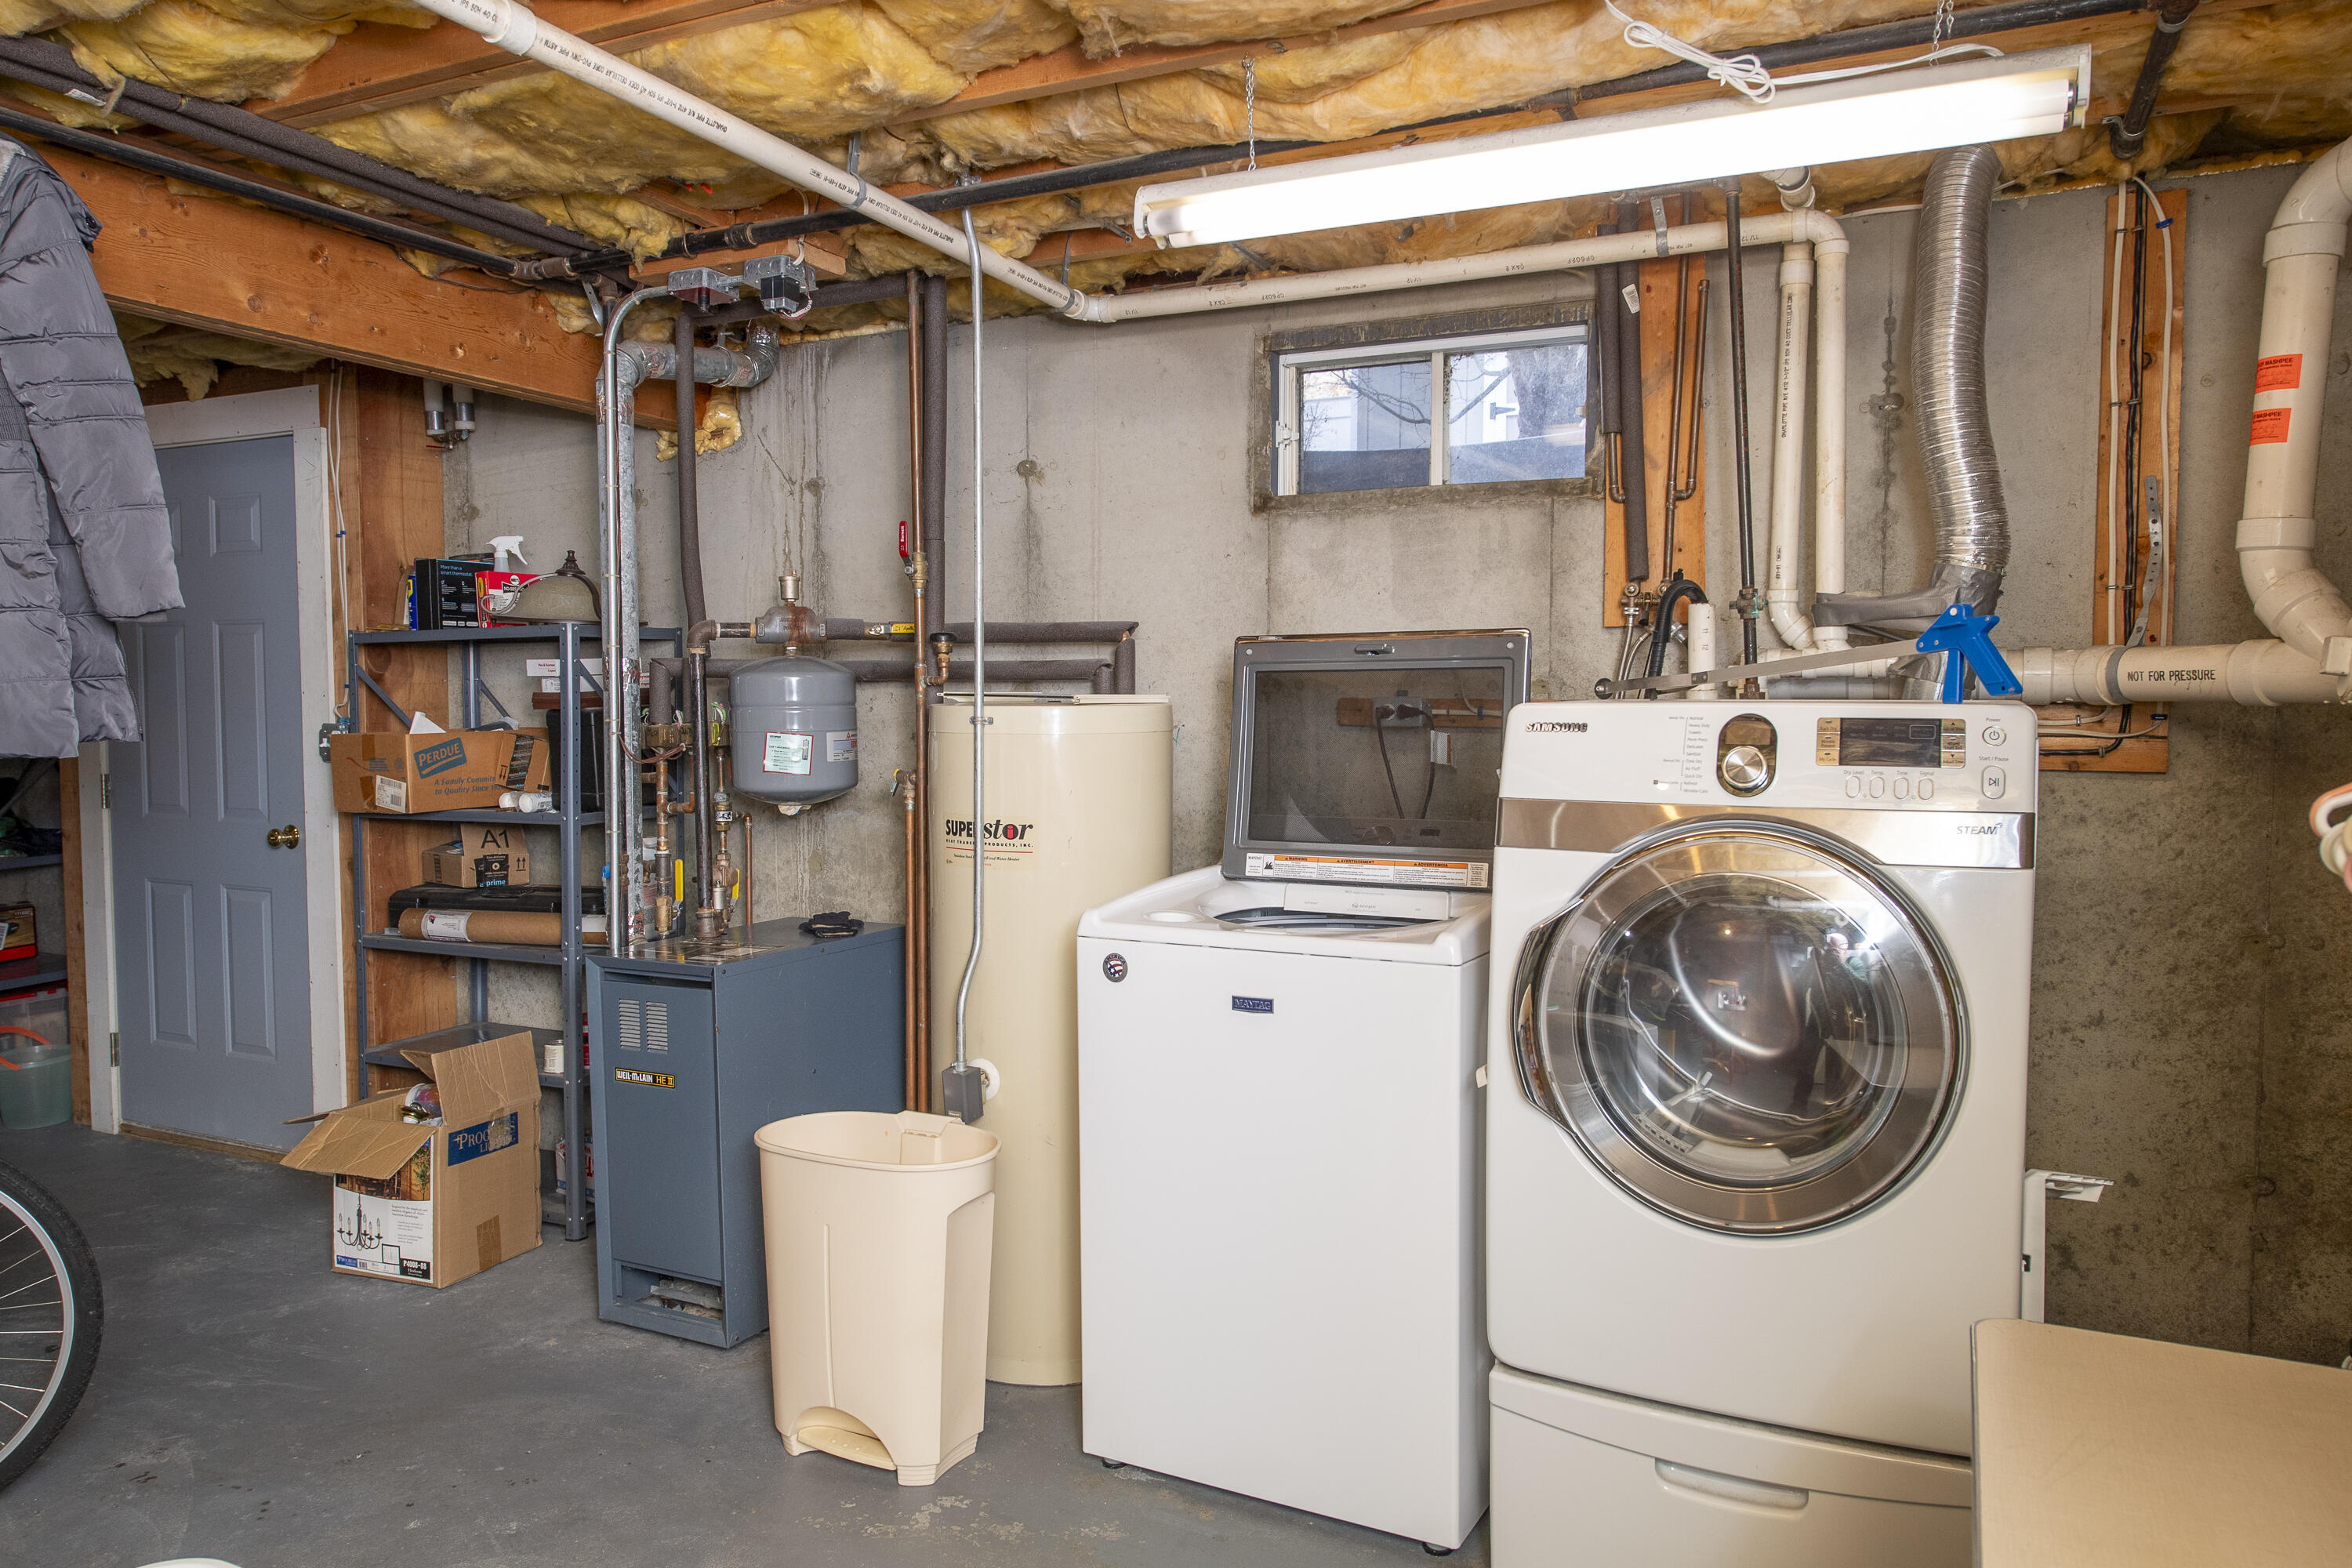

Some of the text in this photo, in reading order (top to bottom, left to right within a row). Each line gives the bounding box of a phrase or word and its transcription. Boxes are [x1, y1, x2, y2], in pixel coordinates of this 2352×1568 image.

[483, 9, 491, 19] 40
[544, 38, 558, 51] ASTM
[593, 63, 604, 74] CORE
[605, 69, 627, 84] CELLULAR
[696, 113, 705, 122] PIPE
[706, 118, 728, 133] CHARLOTTE
[2265, 358, 2293, 366] MASHPEE
[2127, 670, 2216, 682] NOT FOR PRESSURE
[1526, 721, 1588, 732] SAMSUNG
[419, 743, 460, 767] PERDUE
[442, 777, 465, 786] Family
[466, 775, 495, 784] Commit
[444, 786, 470, 796] Quality
[1957, 826, 1998, 835] STEAM
[481, 829, 510, 849] A1
[486, 879, 506, 887] prime
[1105, 953, 1126, 965] AMERICA
[1235, 999, 1271, 1010] MAYTAG
[655, 1076, 666, 1086] HE
